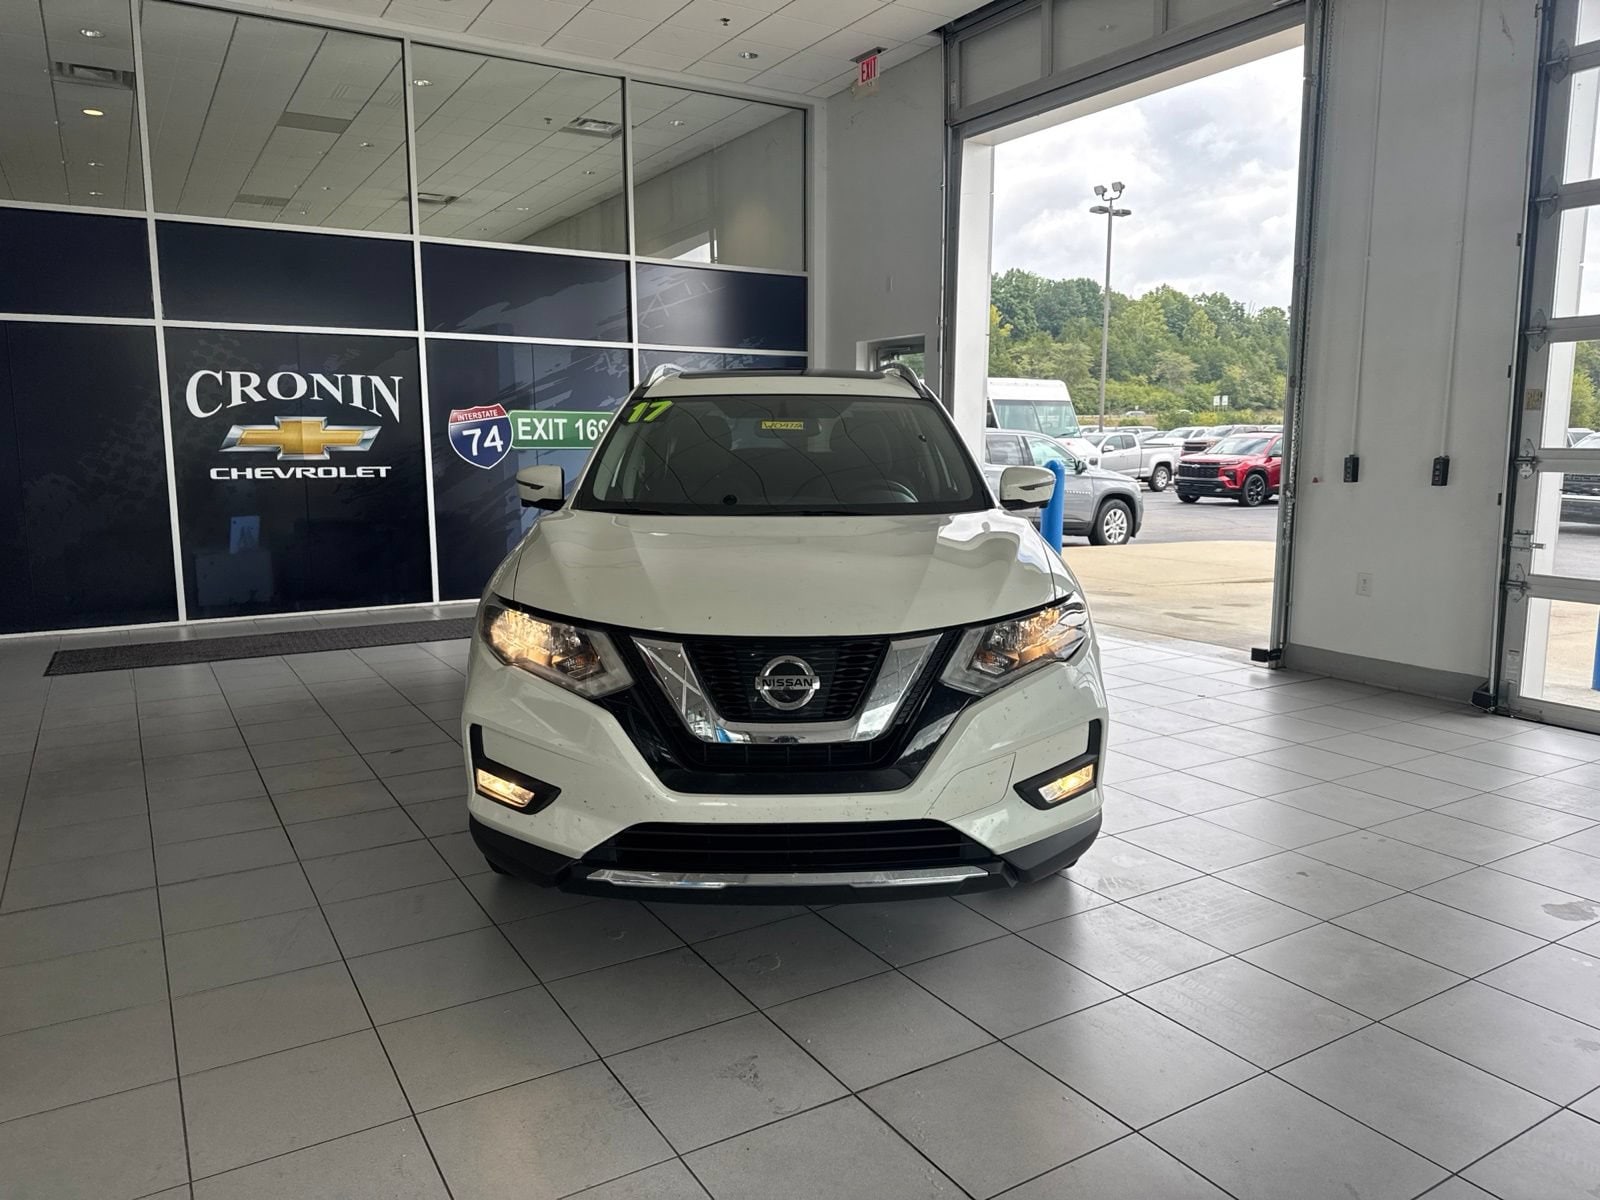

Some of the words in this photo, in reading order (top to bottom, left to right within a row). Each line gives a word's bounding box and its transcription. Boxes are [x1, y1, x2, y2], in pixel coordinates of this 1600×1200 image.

[861, 55, 877, 83] EXIT
[186, 369, 403, 423] CRONIN
[457, 409, 498, 422] INTERSTATE
[628, 401, 673, 423] 17
[462, 425, 504, 456] 74
[517, 418, 568, 441] EXIT
[209, 466, 392, 480] CHEVROLET
[762, 678, 813, 687] NISSAN
